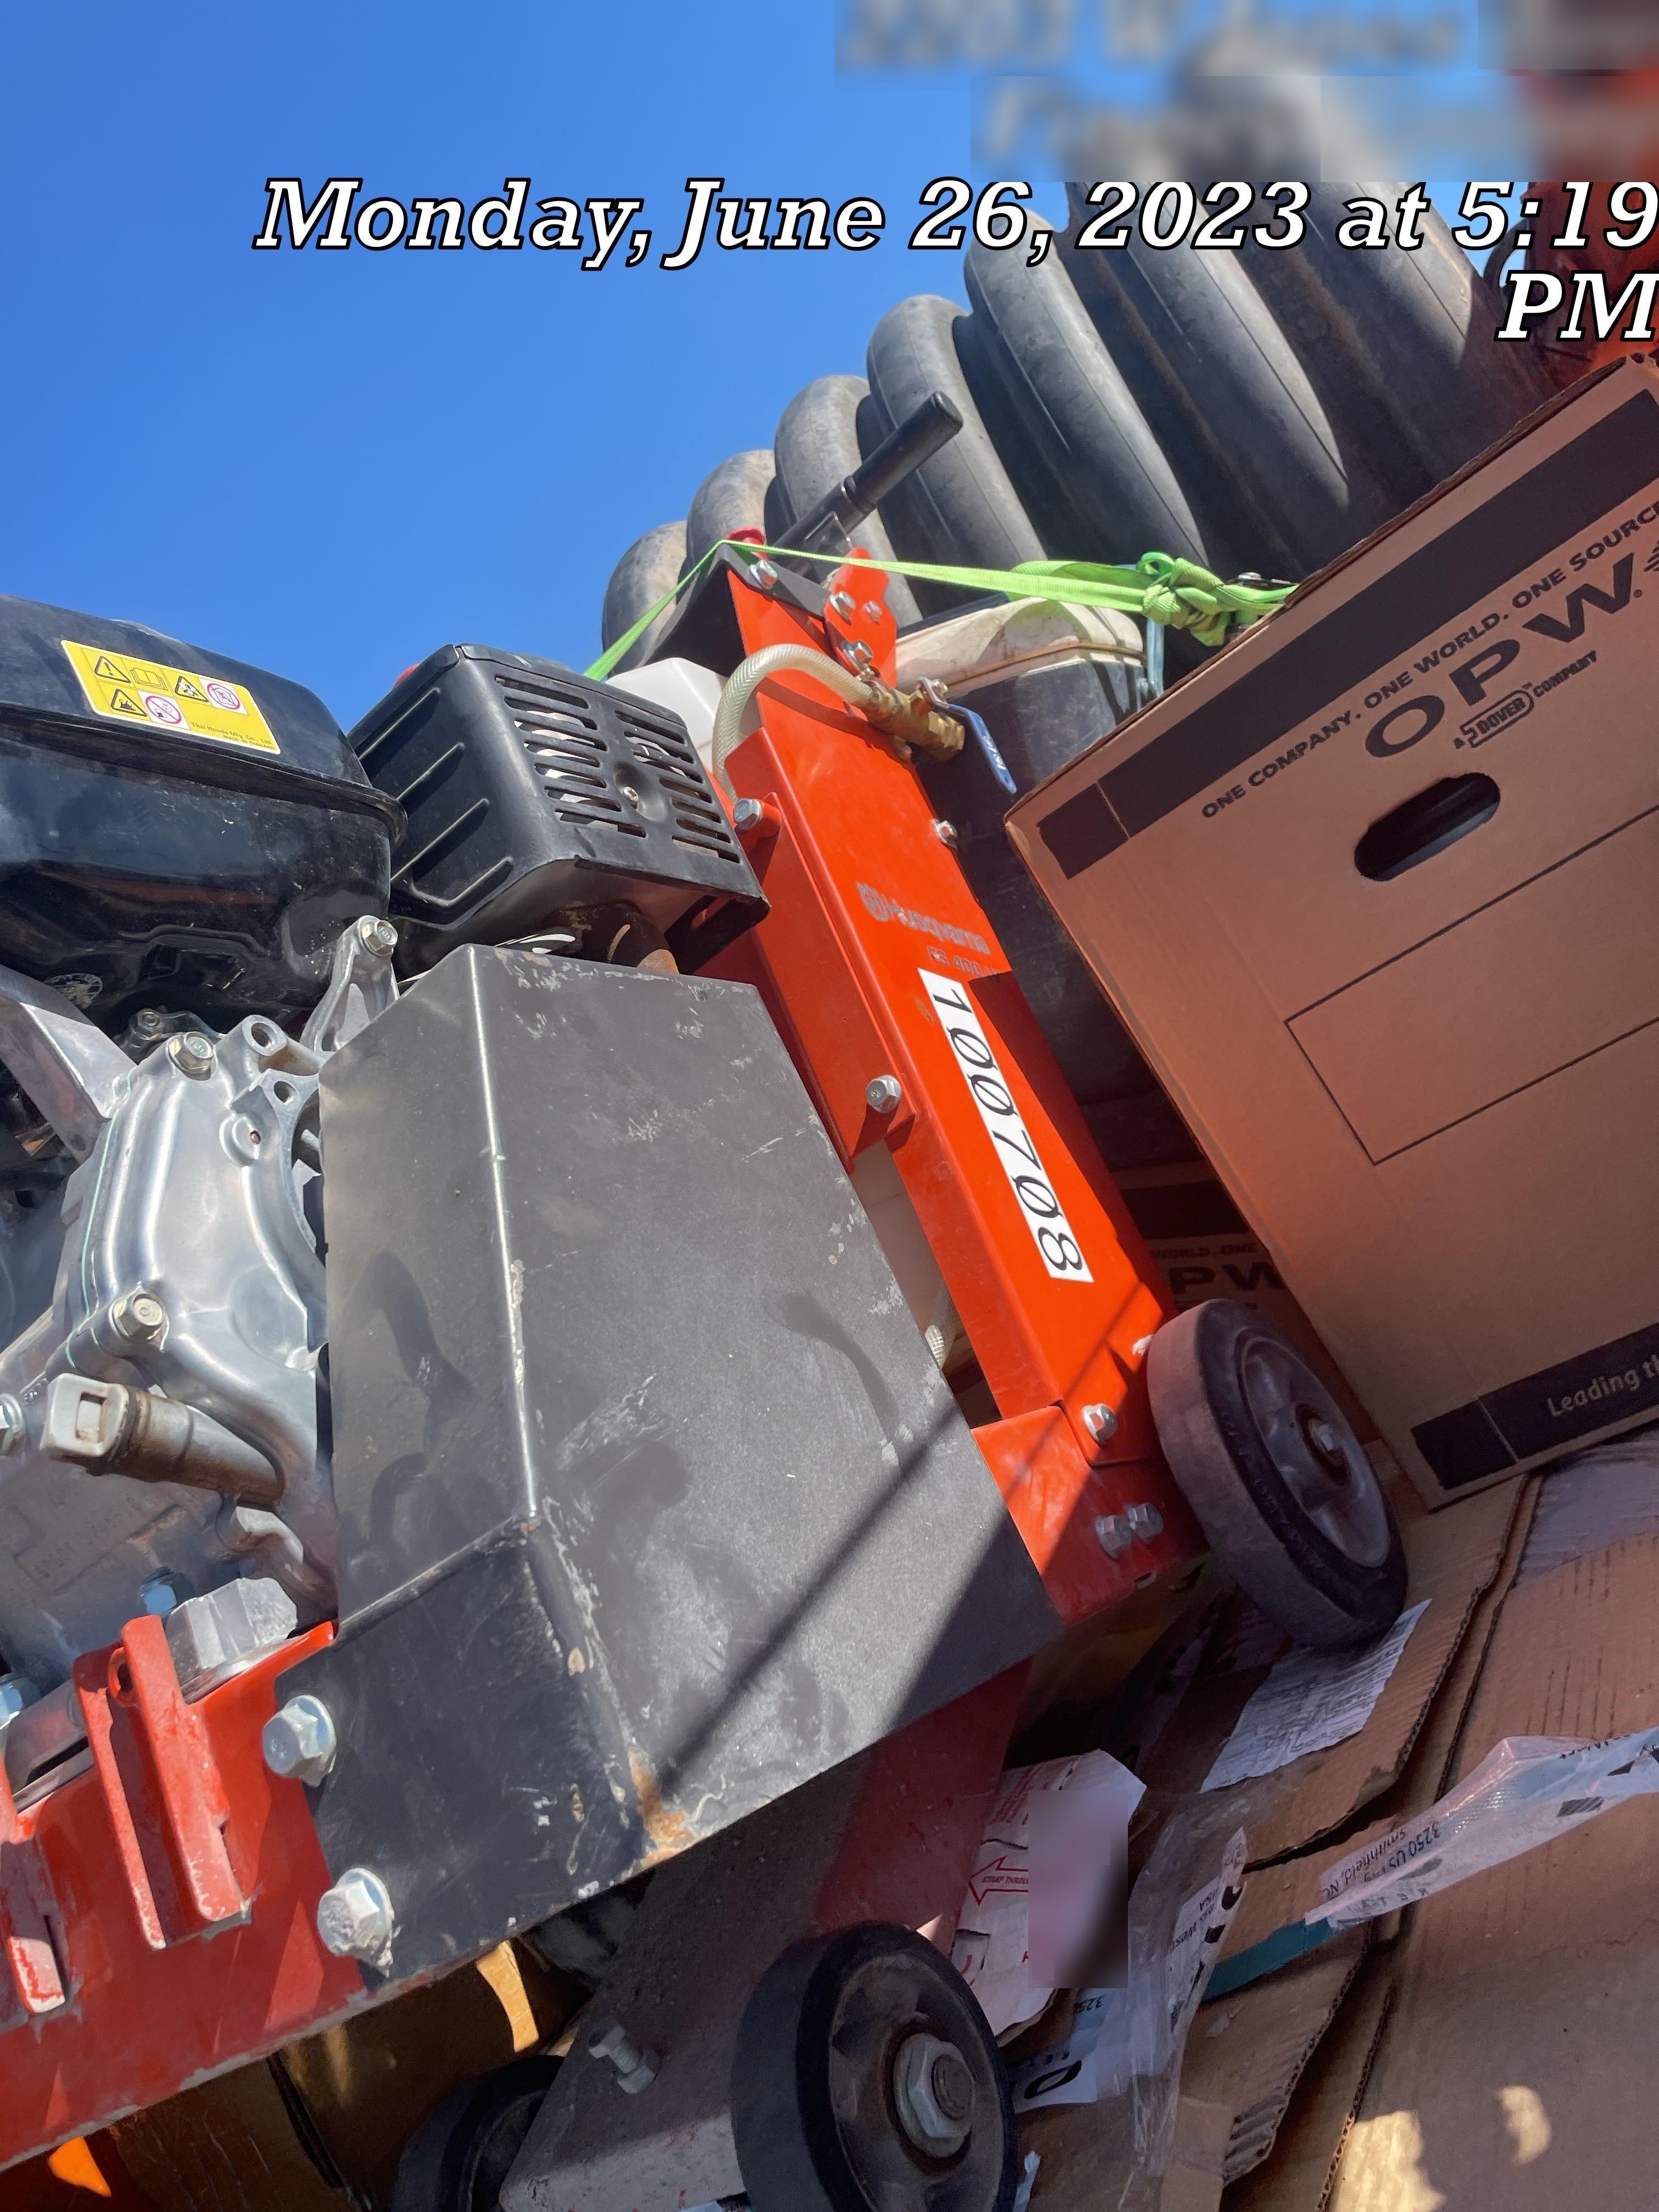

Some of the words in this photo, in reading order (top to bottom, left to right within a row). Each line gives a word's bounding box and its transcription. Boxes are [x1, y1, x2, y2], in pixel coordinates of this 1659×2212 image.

[1365, 551, 1635, 758] OPW
[1201, 785, 1246, 818] ONE
[1248, 710, 1361, 787] COMPANY.
[1364, 671, 1414, 708] ONE
[1414, 612, 1509, 673] WORLD.
[1512, 568, 1567, 608] ONE
[1476, 697, 1526, 735] DOVER
[1533, 650, 1597, 697] COMPANY
[190, 721, 206, 730] Thai
[207, 726, 228, 735] Honda
[882, 894, 992, 956] Husqvarna
[953, 955, 983, 978] 400
[932, 988, 1084, 1272] 100708
[1169, 1262, 1286, 1295] PW
[1548, 1369, 1640, 1417] Leading
[1407, 1820, 1442, 1858] 3250
